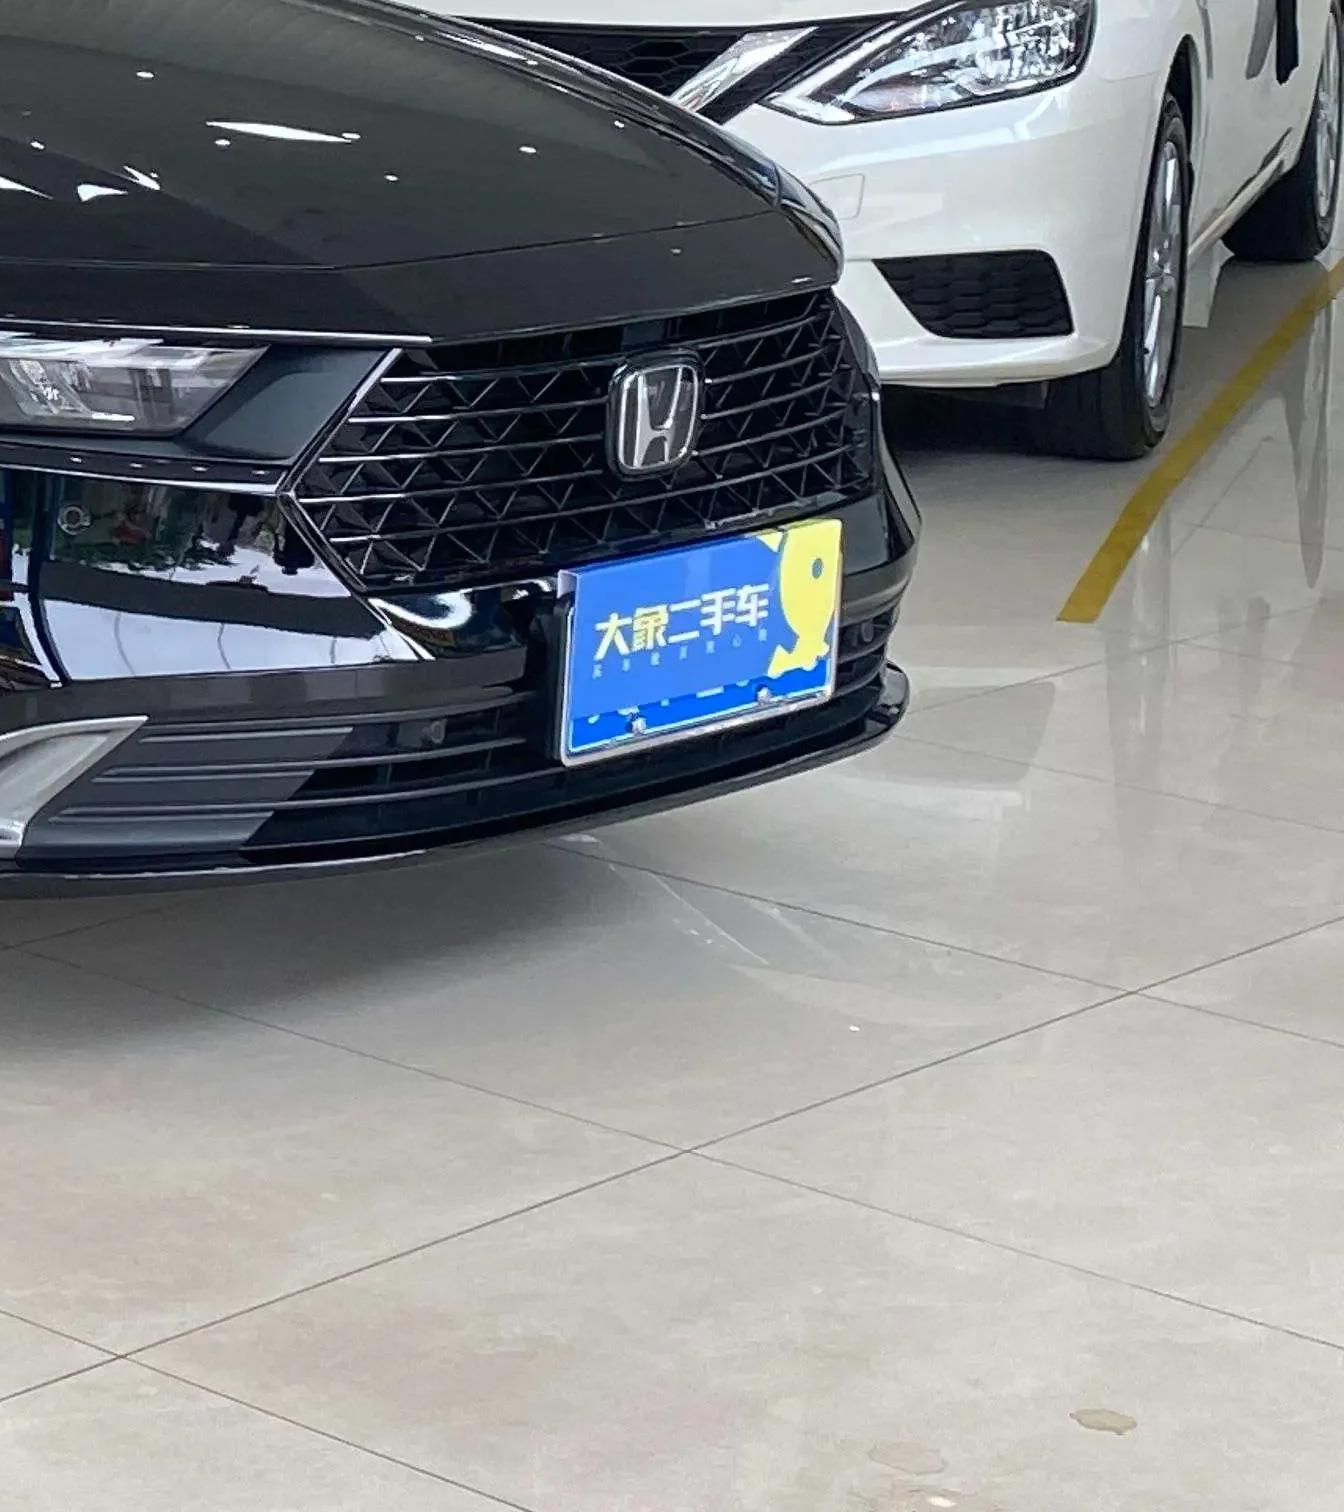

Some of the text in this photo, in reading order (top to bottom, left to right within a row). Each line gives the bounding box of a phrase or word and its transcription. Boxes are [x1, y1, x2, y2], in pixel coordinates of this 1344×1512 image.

[593, 583, 770, 661] 大象二手车
